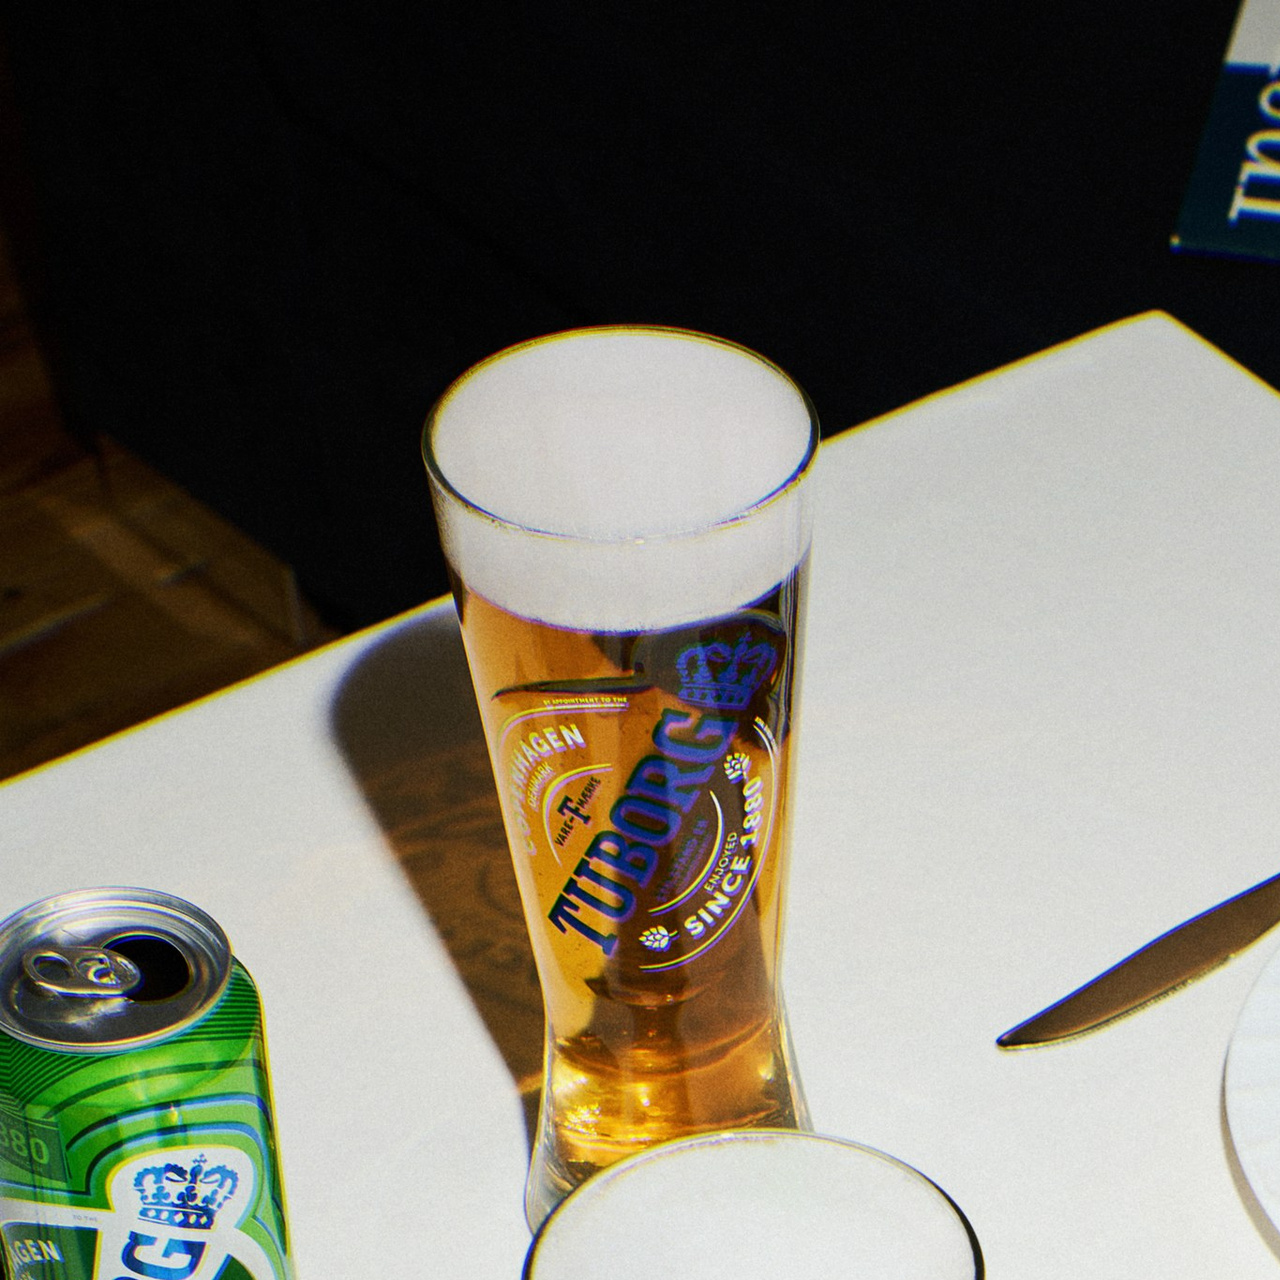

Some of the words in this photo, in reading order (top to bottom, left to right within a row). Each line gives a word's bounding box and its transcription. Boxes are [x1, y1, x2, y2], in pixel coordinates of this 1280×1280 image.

[546, 705, 743, 958] TUBORG
[682, 851, 753, 941] SINCE
[739, 774, 766, 848] 1880
[704, 830, 739, 895] ENJOYED
